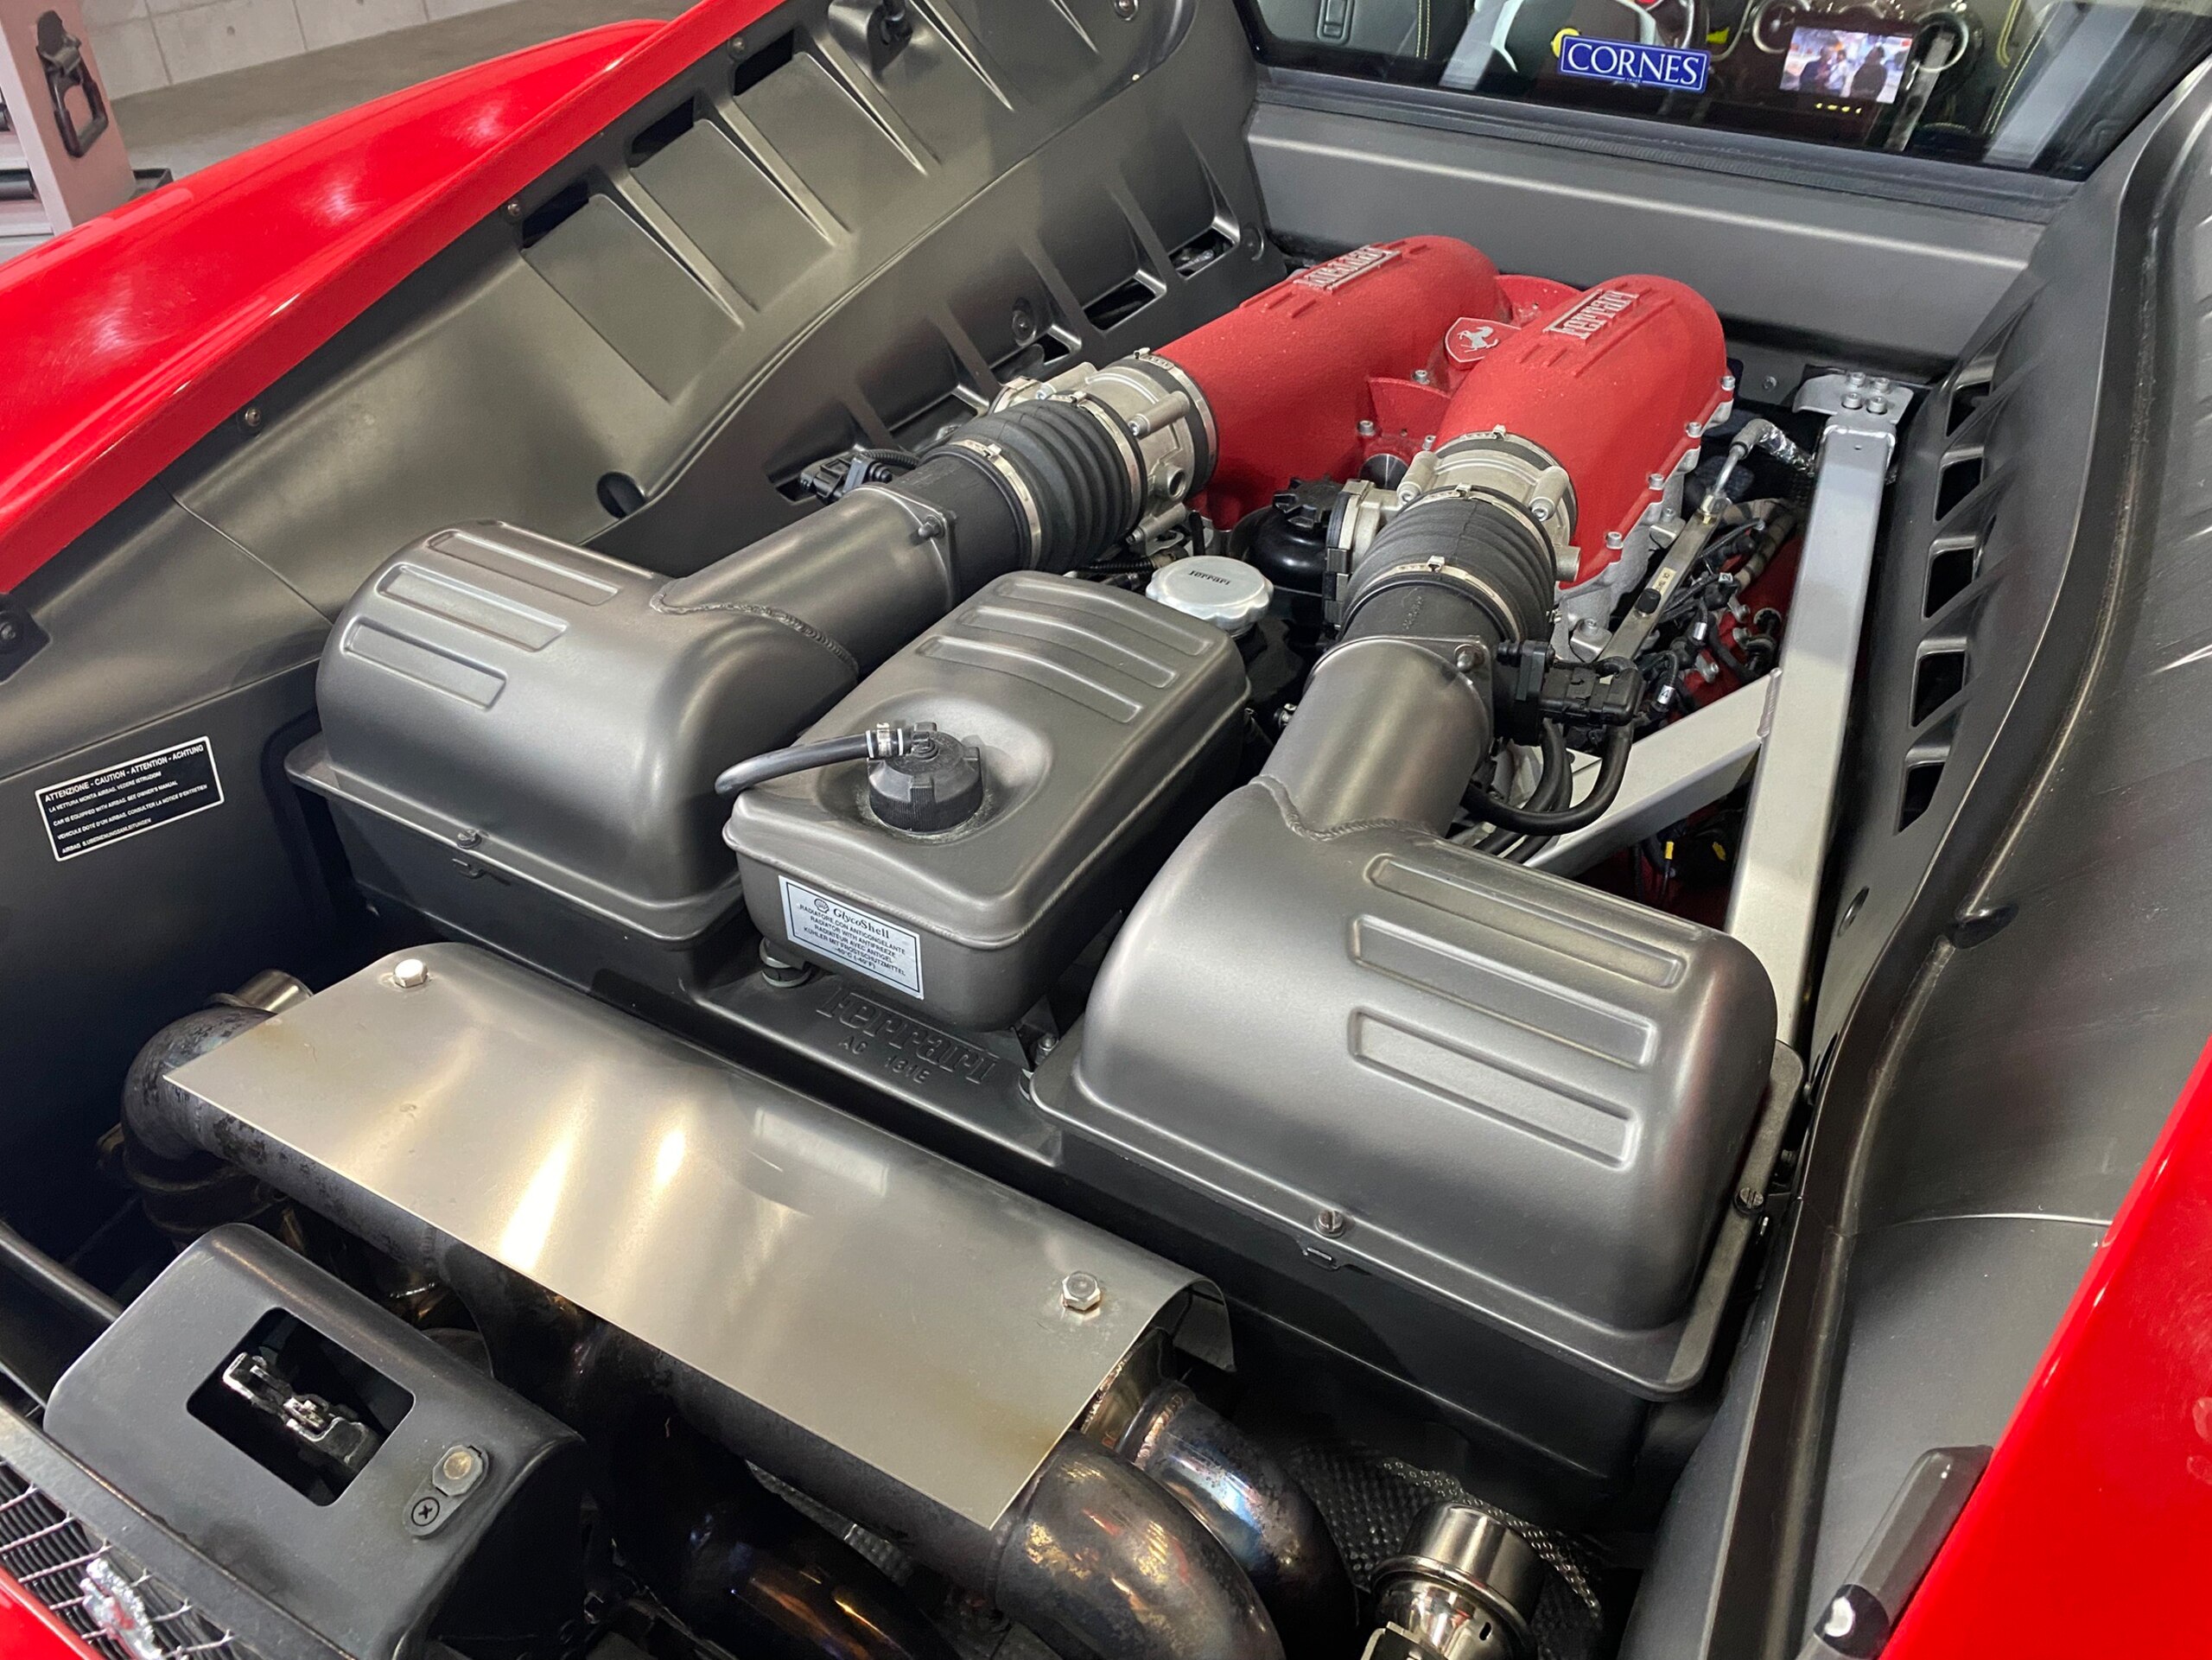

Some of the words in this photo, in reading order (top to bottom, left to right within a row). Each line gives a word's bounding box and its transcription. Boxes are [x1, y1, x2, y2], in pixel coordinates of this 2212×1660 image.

[1567, 42, 1700, 85] CORNES
[1542, 289, 1639, 339] Ferrari
[1188, 570, 1231, 585] Ferrari
[45, 782, 89, 802] ATTENZIONE
[94, 770, 125, 785] CAUTION
[131, 756, 168, 773] ATTENTION
[173, 744, 203, 760] ACHTUNG
[56, 799, 79, 810] VETTURA
[79, 792, 97, 802] MONTA
[117, 779, 135, 790] VEDERE
[70, 809, 95, 820] EQUIPPED
[137, 786, 158, 798] OWNER'S
[158, 781, 178, 790] MANUAL
[127, 802, 156, 815] CONSULTER
[162, 794, 179, 803] NOTICE
[179, 785, 207, 798] D'ENTRETIEN
[799, 904, 834, 924] RADIATORE
[835, 919, 848, 930] CON
[849, 926, 905, 955] ANTICONGELANTE
[810, 915, 840, 933] RADIATOR
[842, 929, 856, 940] WITH
[858, 938, 895, 957] ANTIFREEZE
[833, 908, 889, 939] GlycoShell
[814, 924, 848, 944] RADIATEUR
[849, 940, 866, 951] AVEC
[866, 946, 892, 963] ANTIGEL
[829, 938, 839, 946] MIT
[840, 942, 906, 976] FROSTSCHUTZMITTEL
[816, 987, 1000, 1084] Ferrari
